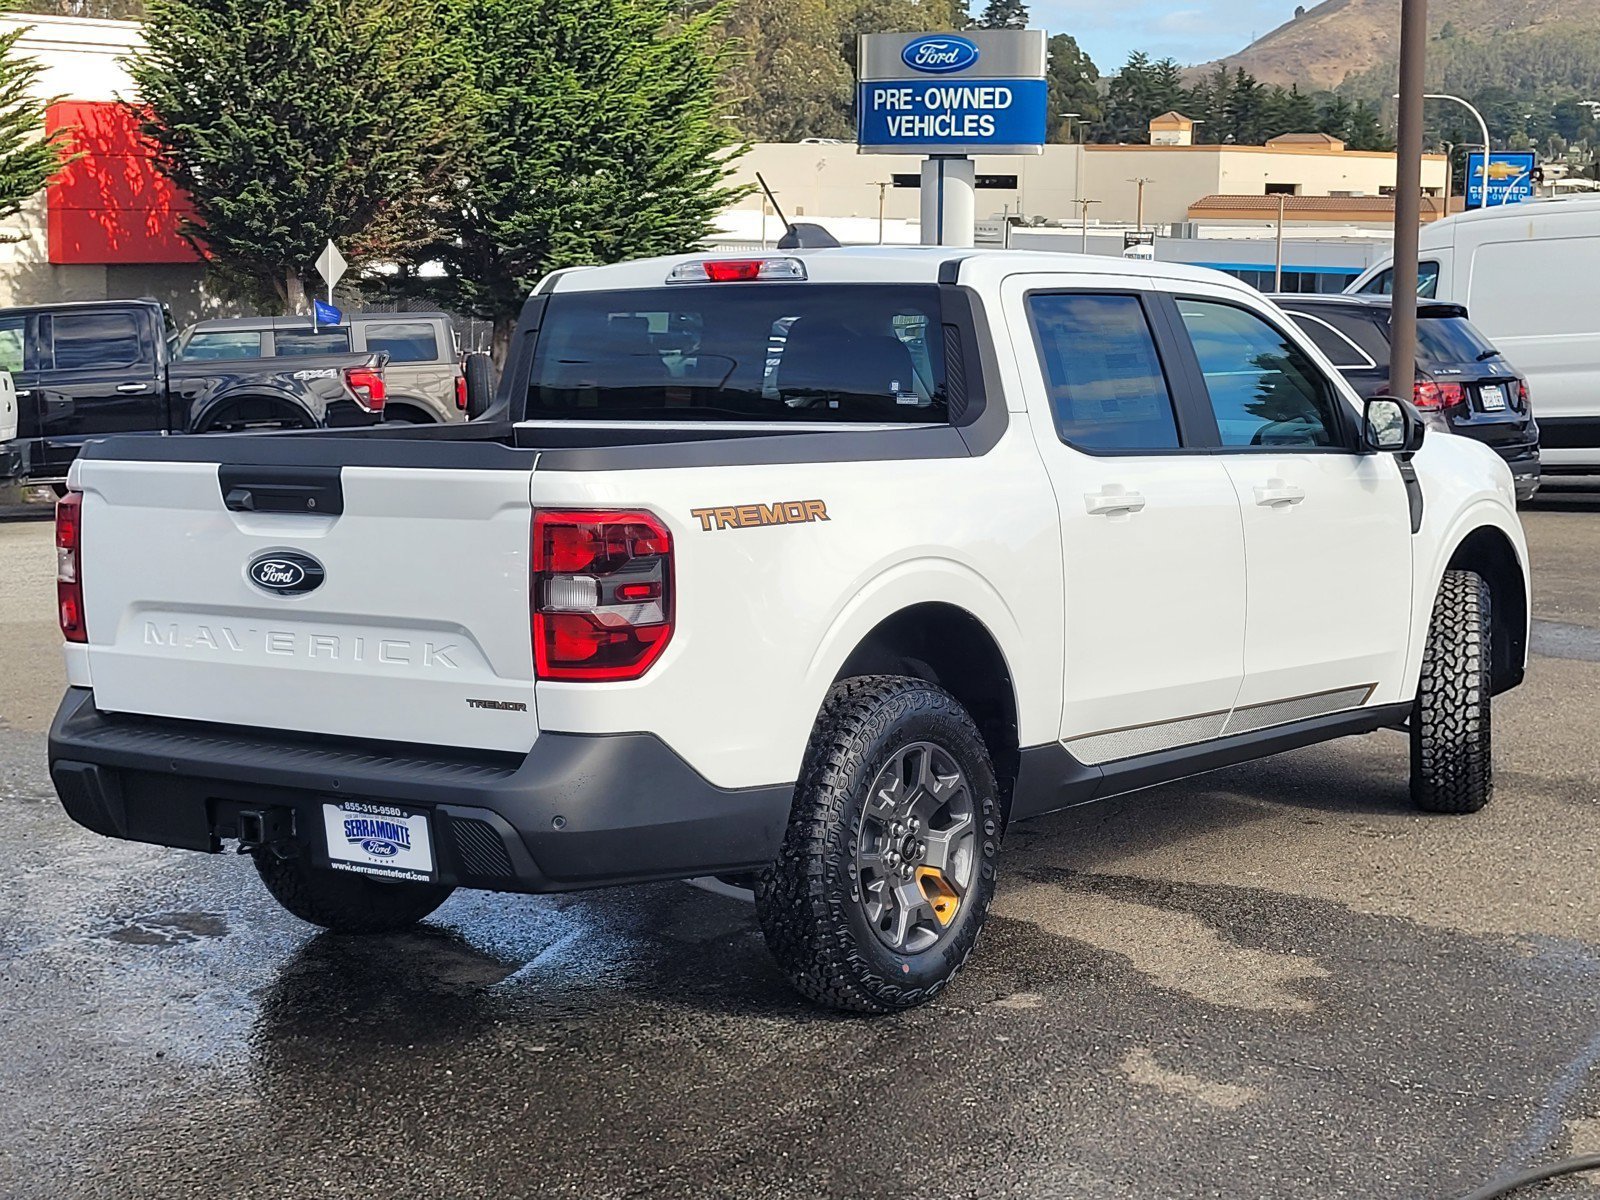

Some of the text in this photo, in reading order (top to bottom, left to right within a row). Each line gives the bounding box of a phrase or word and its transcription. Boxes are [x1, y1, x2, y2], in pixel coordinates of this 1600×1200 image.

[915, 43, 959, 64] Ford
[873, 87, 1013, 110] PRE-OWNED
[886, 114, 996, 137] VEHICLES
[690, 499, 831, 532] TREMOR
[260, 562, 294, 583] Ford
[143, 620, 459, 670] MAVERICK
[465, 698, 528, 713] TREMOR
[344, 801, 401, 817] 855-315-9580
[343, 819, 411, 846] SERRAMONTE
[367, 841, 392, 855] Ford
[331, 861, 430, 882] www.serramonteford.com
